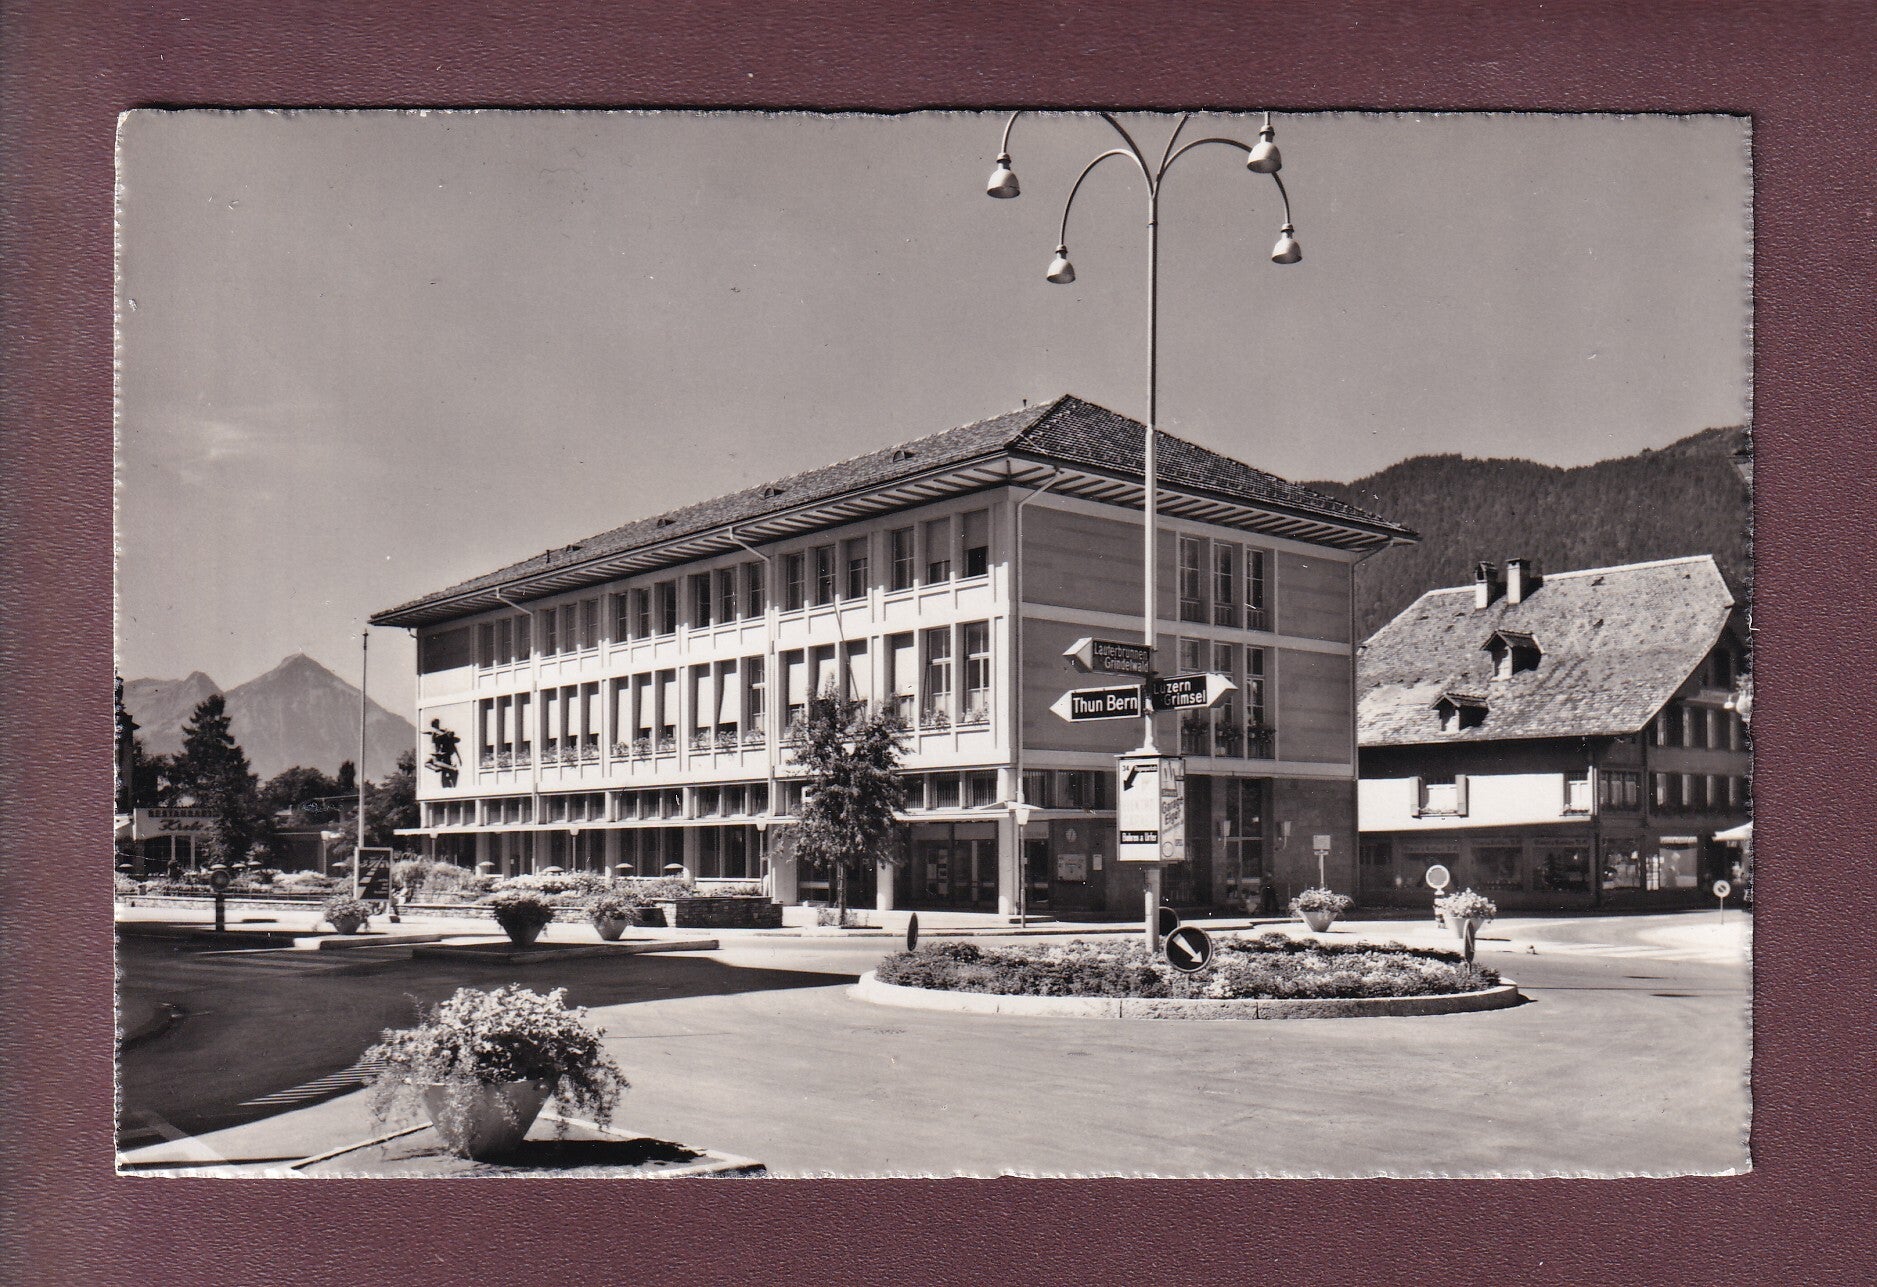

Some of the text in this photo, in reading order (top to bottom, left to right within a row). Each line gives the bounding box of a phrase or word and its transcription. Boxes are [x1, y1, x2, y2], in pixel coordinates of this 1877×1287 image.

[1093, 642, 1148, 660] Lauterbrunnen
[1104, 656, 1149, 672] Grindelwald
[1153, 681, 1191, 695] Luzern
[1073, 694, 1138, 714] Thun Bern
[1164, 689, 1206, 706] Grimsel
